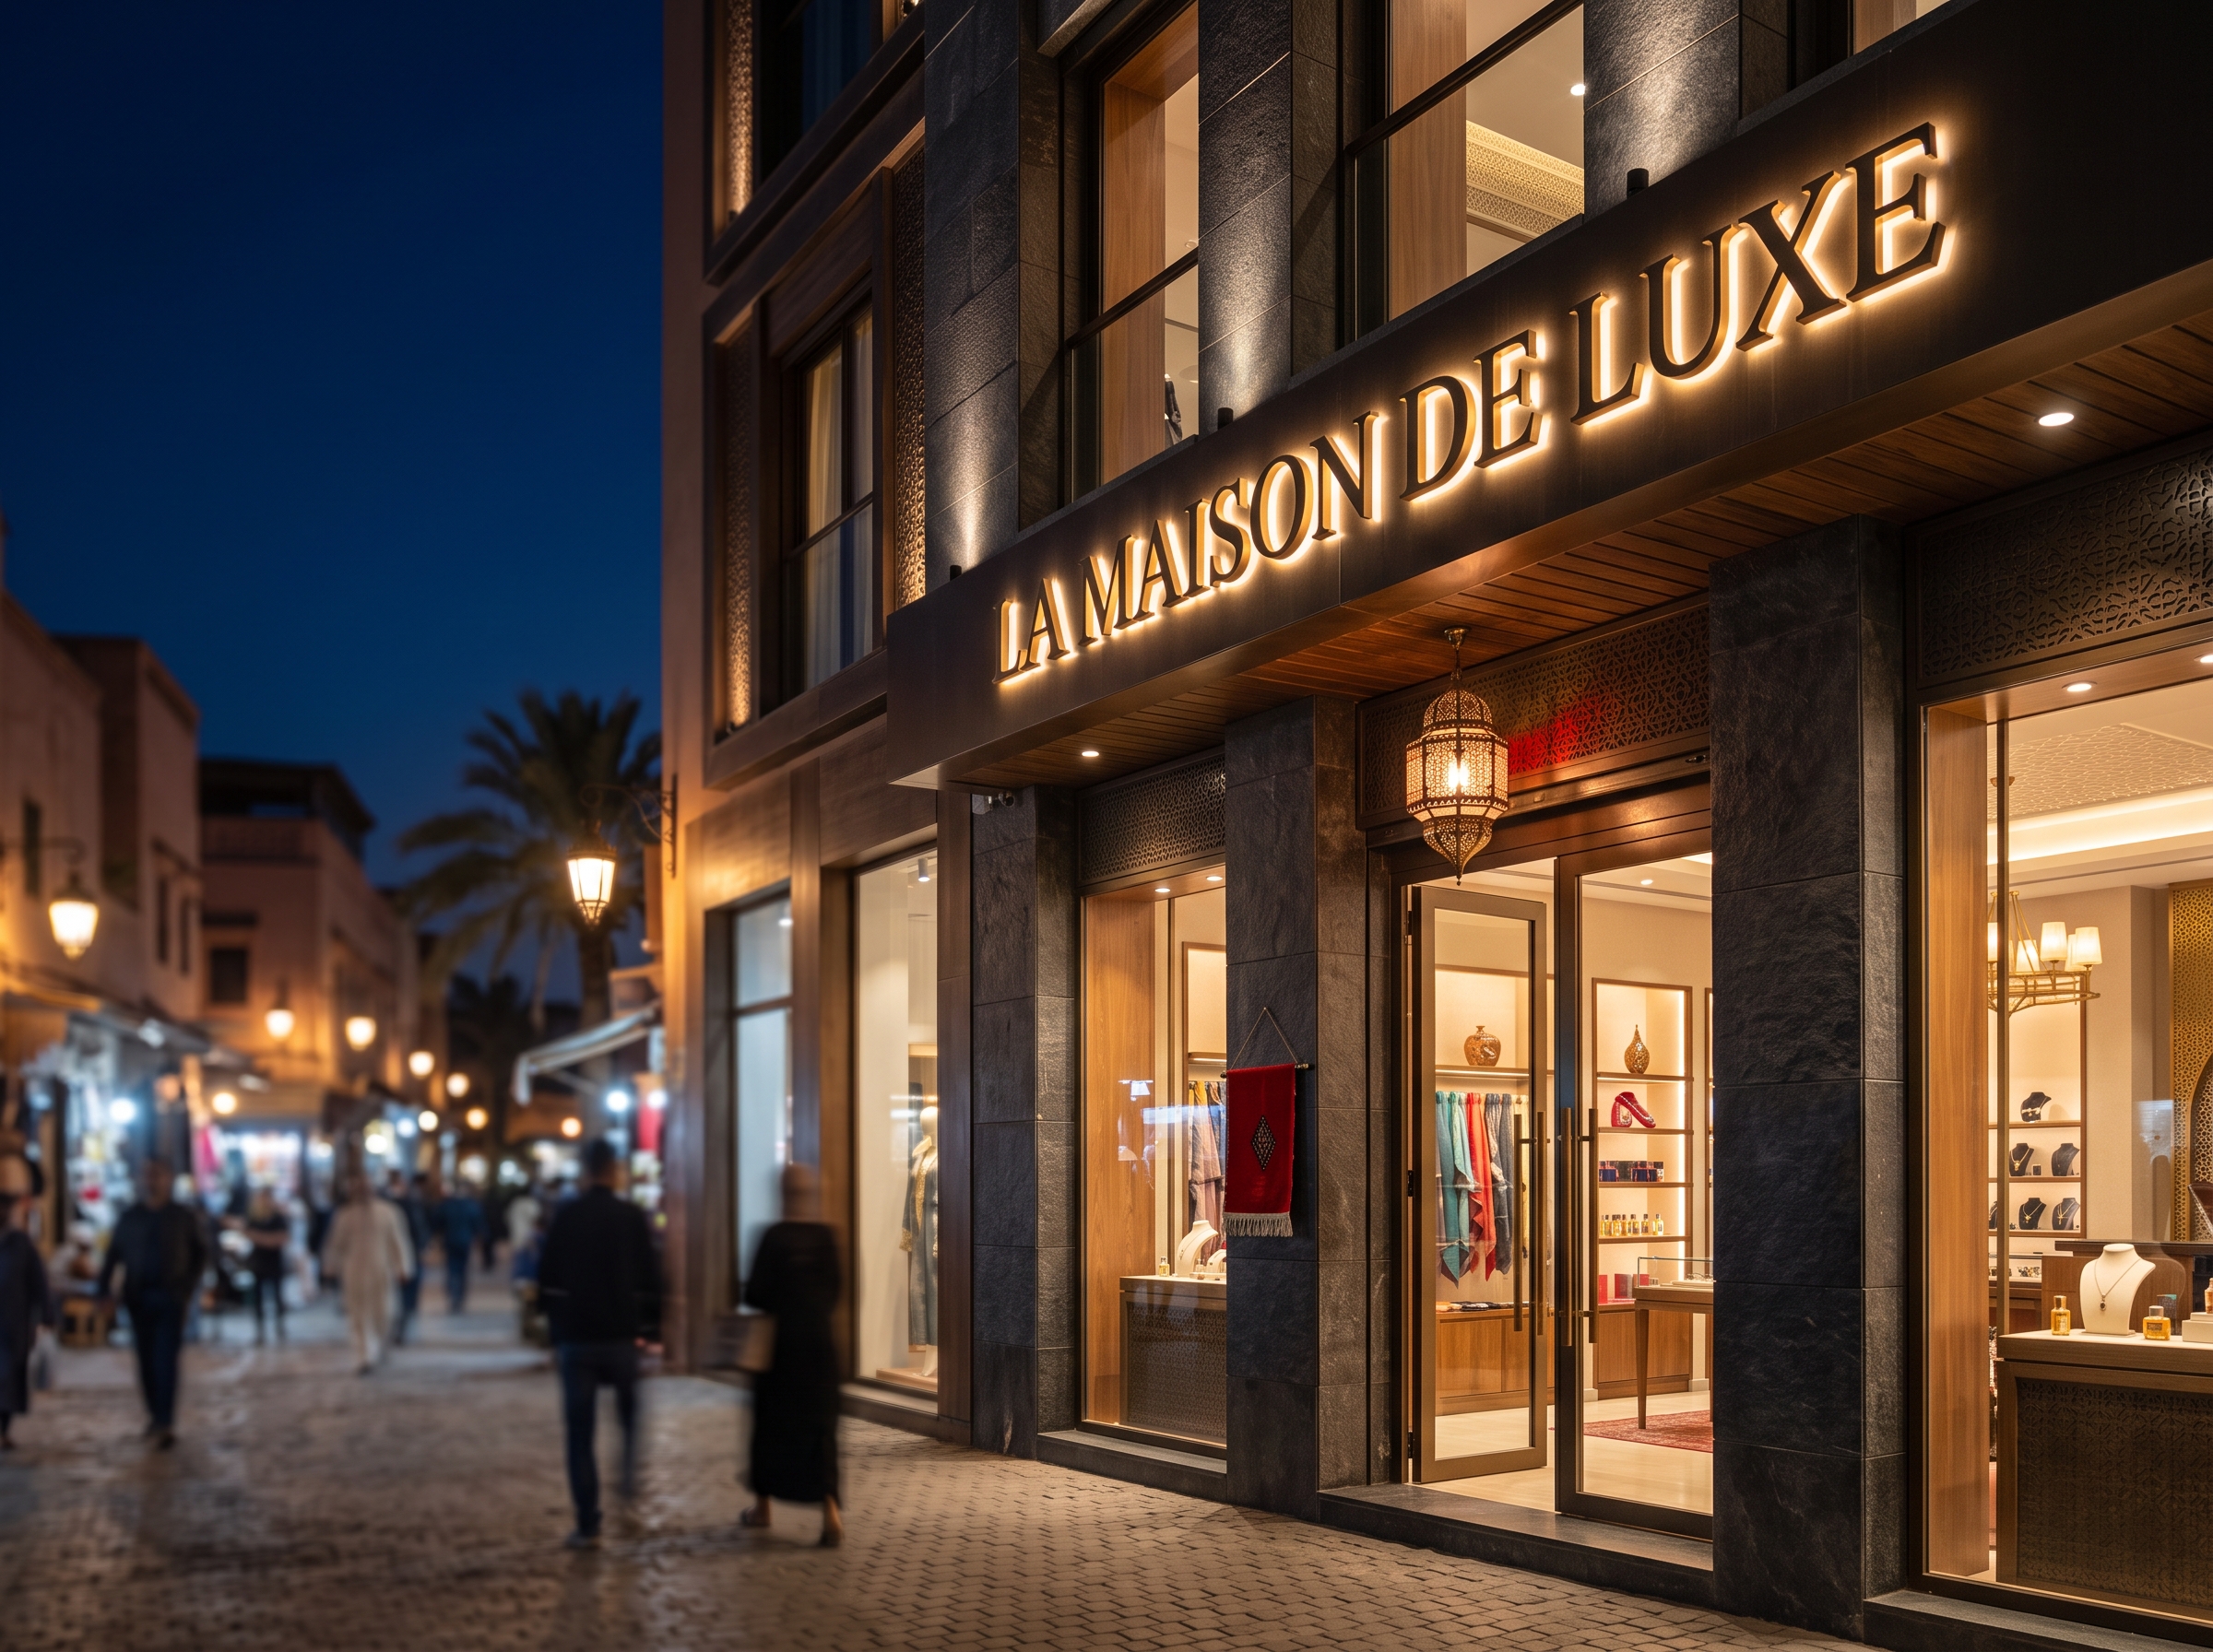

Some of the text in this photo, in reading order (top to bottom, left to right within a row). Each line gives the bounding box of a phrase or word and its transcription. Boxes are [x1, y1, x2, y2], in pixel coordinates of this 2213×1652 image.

[992, 122, 1948, 684] LA MAISON DE LUXE
